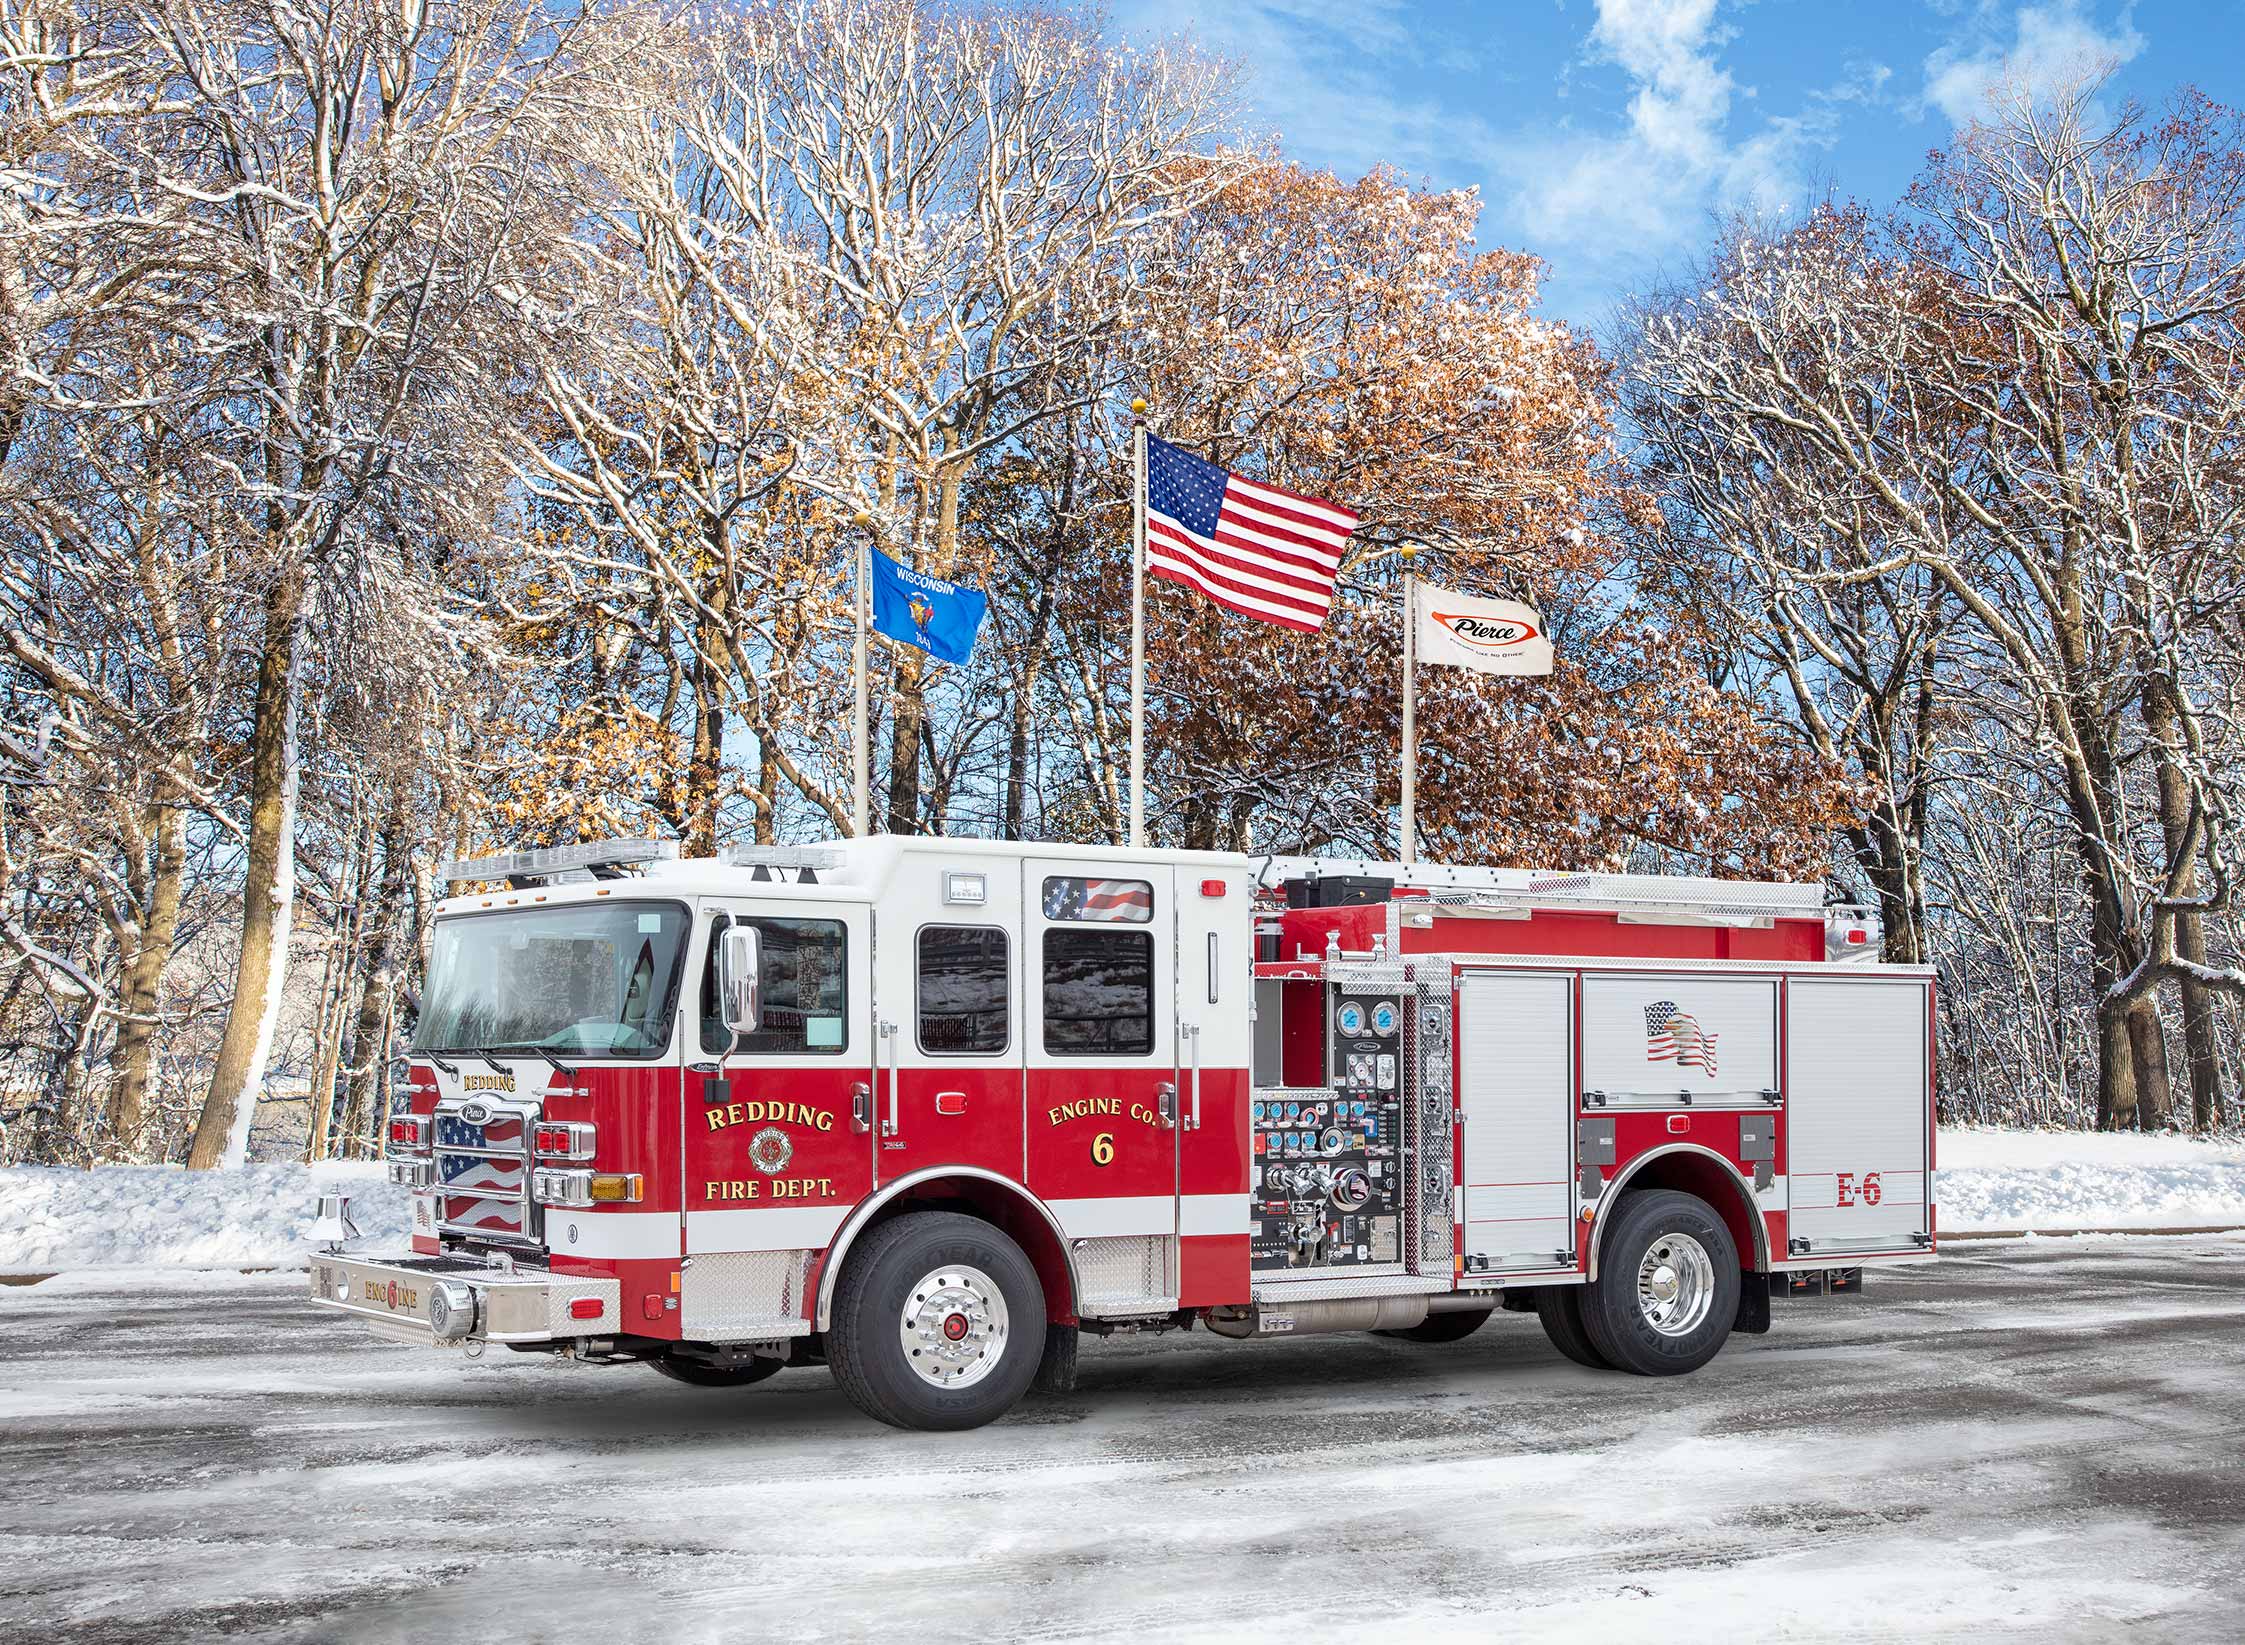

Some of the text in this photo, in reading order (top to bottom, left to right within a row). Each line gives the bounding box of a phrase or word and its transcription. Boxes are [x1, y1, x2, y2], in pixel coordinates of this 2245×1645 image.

[896, 566, 956, 595] WISCONSIN
[1454, 618, 1515, 639] Pierce
[464, 1075, 516, 1092] REDDING
[704, 1100, 834, 1132] REDDING
[1048, 1098, 1122, 1127] ENGINE
[1090, 1132, 1114, 1168] 6
[705, 1179, 836, 1200] FIRE DEPT.
[1836, 1172, 1881, 1207] E-6
